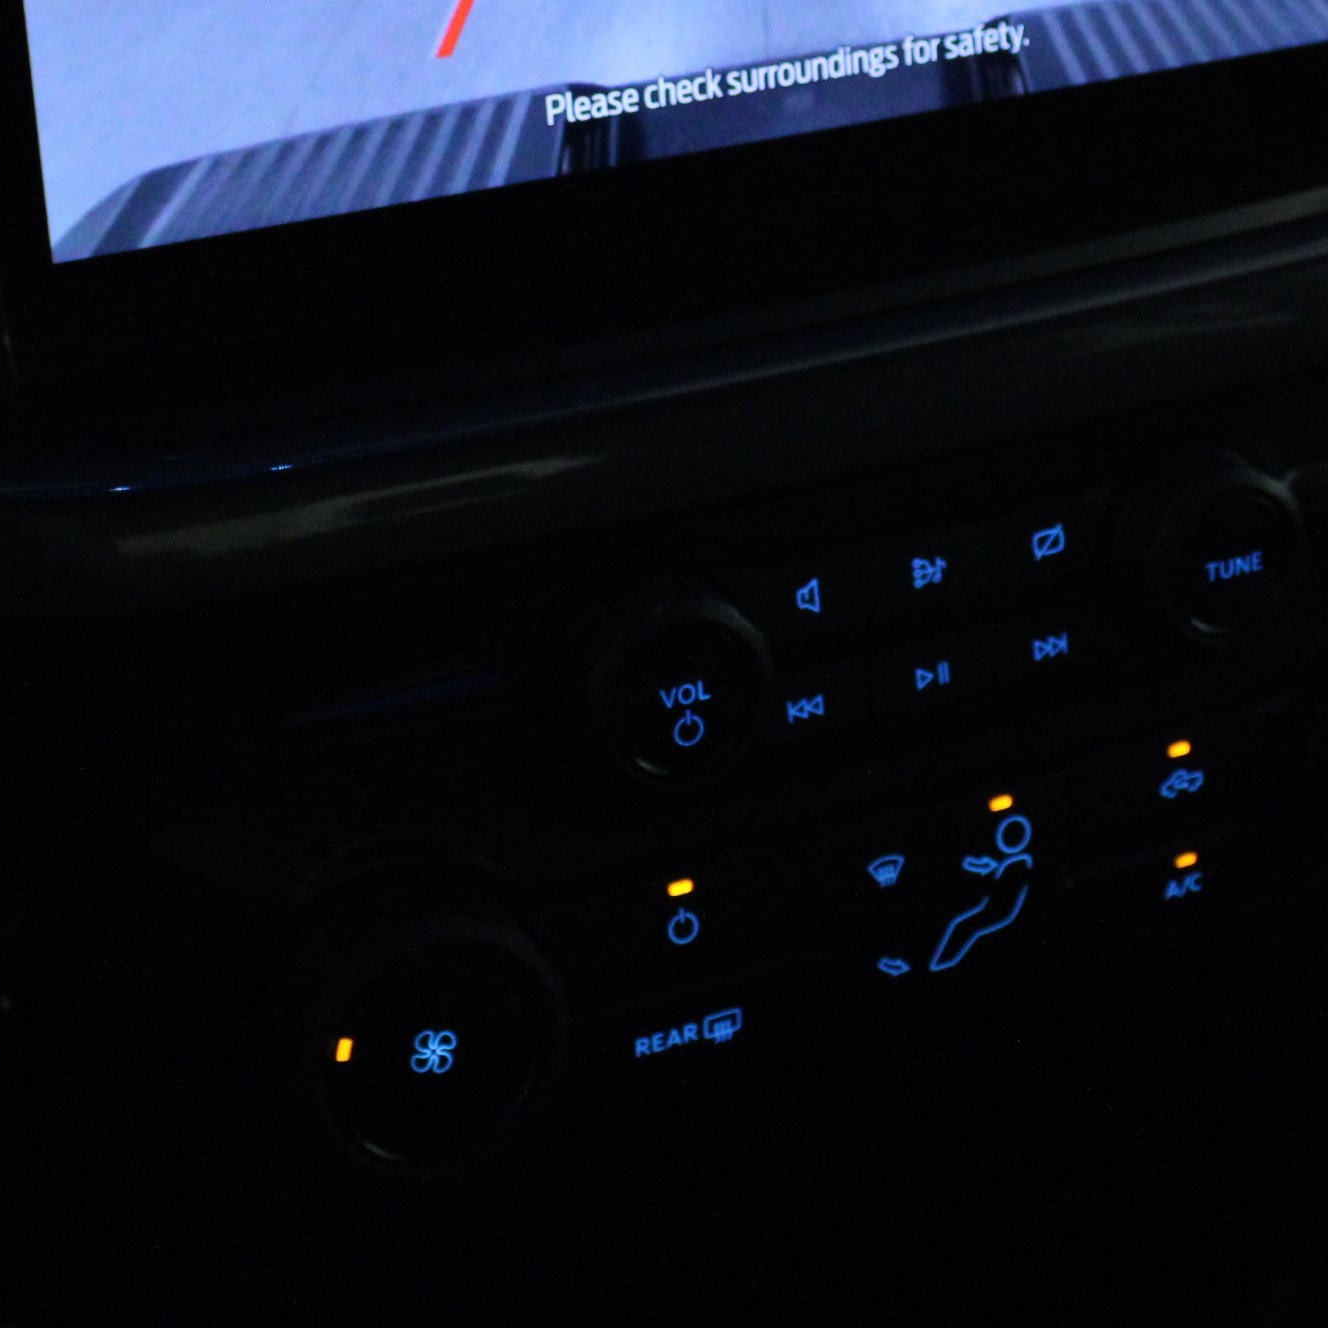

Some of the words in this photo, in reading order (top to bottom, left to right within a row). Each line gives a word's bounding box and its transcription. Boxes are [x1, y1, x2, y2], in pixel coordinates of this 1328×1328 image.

[545, 87, 640, 126] Please
[643, 69, 724, 110] check
[726, 40, 899, 93] surroundings
[902, 34, 942, 66] for
[942, 22, 1032, 61] safety.
[1205, 551, 1264, 583] TUNE
[659, 680, 713, 709] VOL
[1164, 872, 1203, 900] A/C
[634, 1022, 700, 1058] REAR
